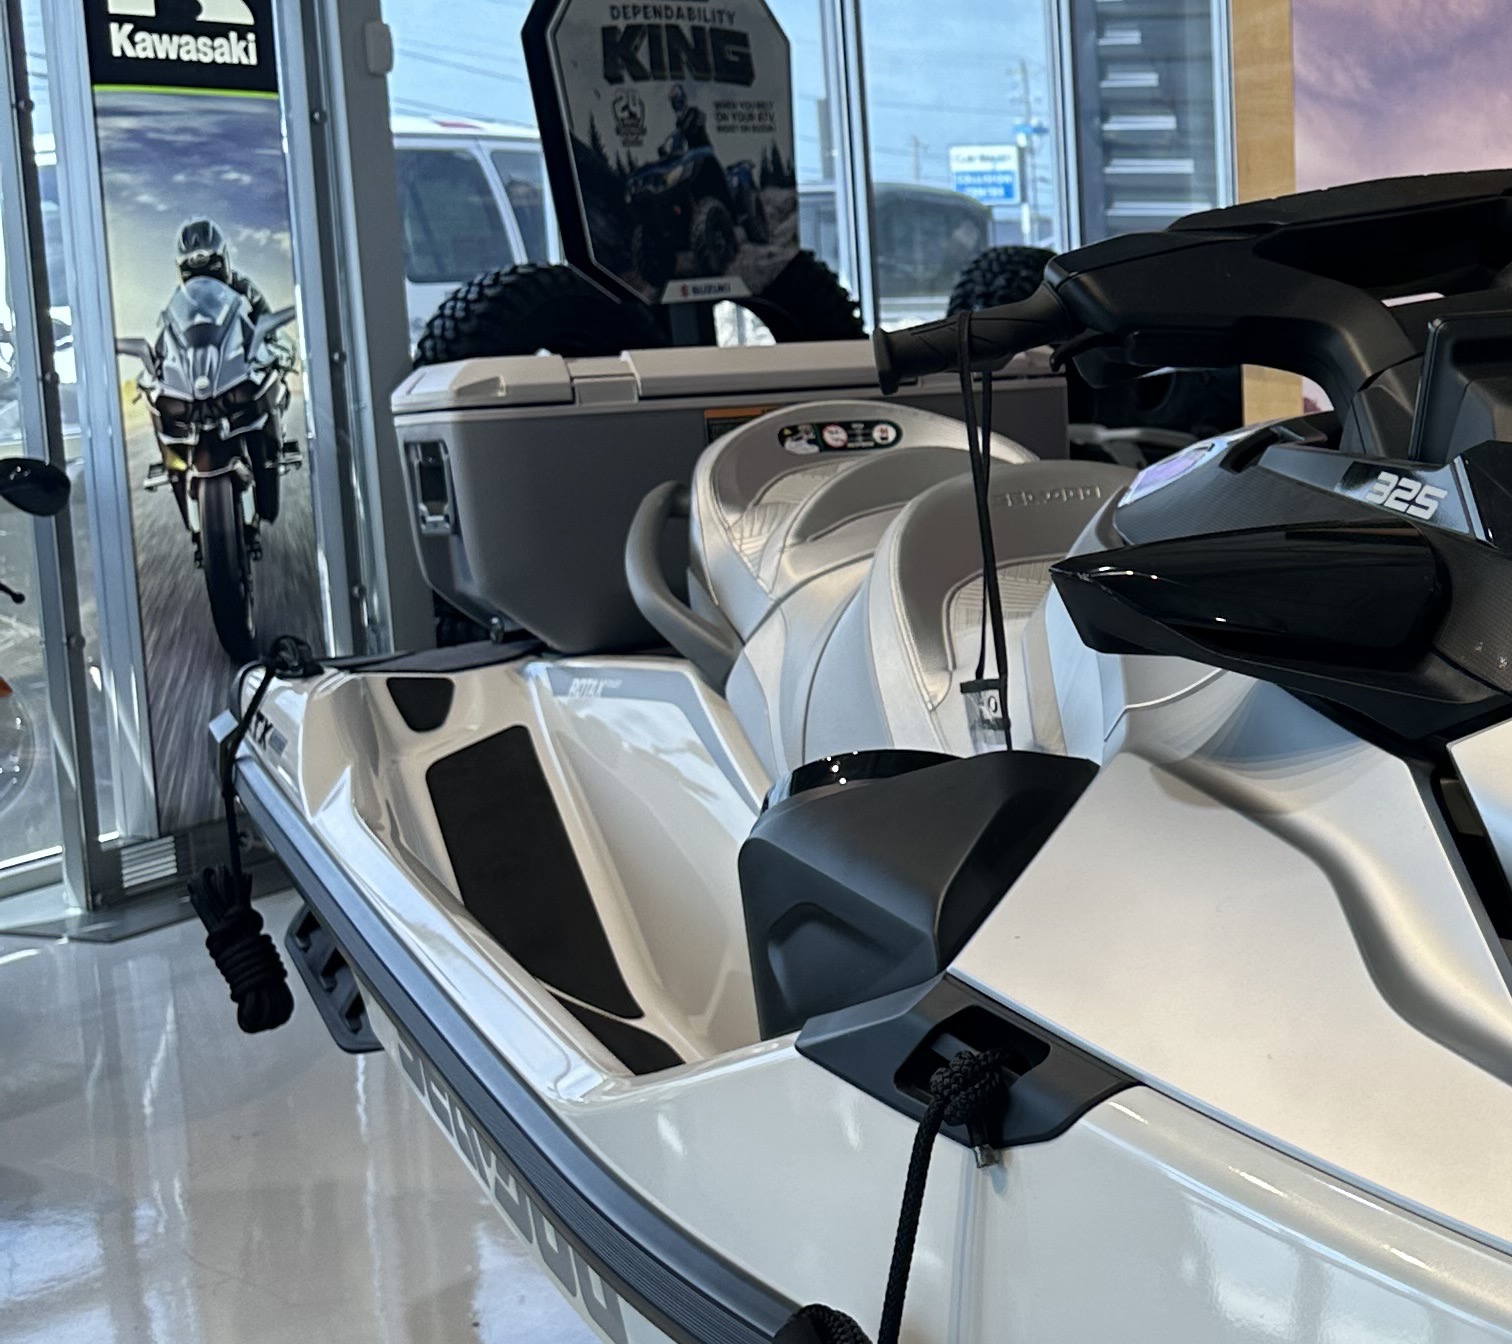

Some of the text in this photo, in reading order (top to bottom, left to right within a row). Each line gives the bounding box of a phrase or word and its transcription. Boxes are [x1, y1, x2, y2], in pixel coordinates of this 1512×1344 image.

[609, 4, 737, 26] DEPENDABILITY
[109, 21, 258, 66] Kawasaki
[601, 23, 756, 87] KING
[1365, 470, 1448, 521] 325
